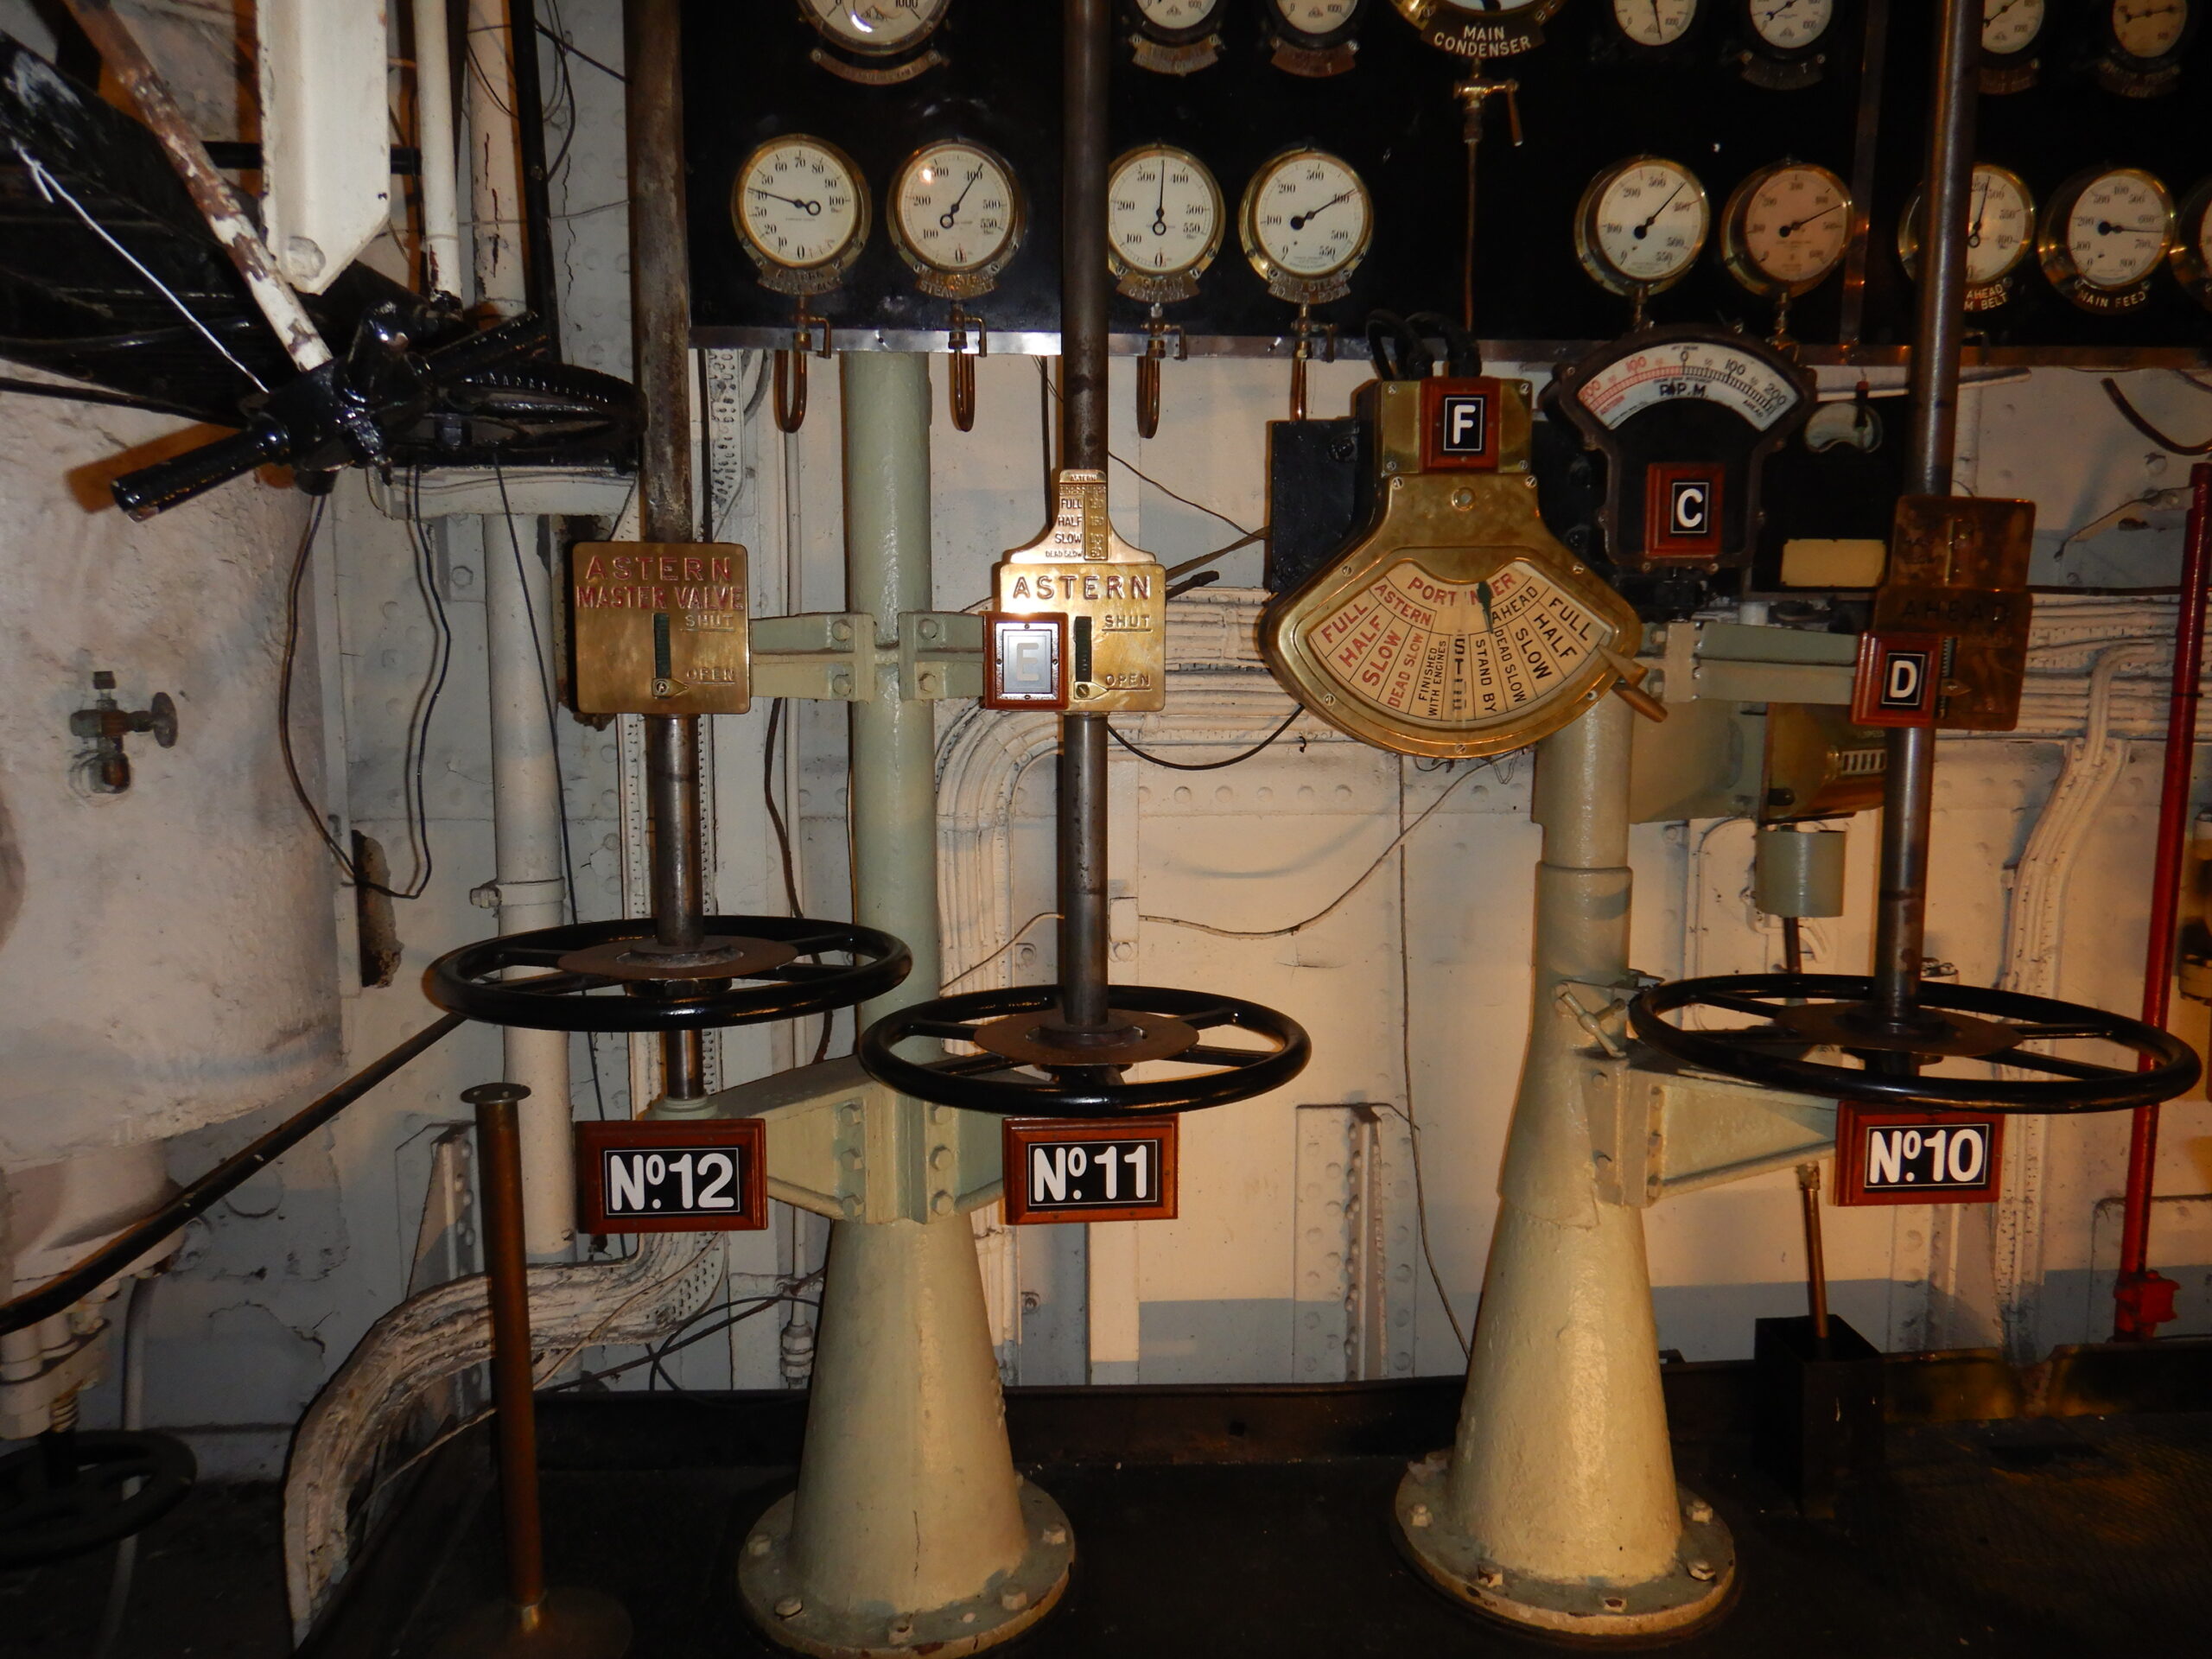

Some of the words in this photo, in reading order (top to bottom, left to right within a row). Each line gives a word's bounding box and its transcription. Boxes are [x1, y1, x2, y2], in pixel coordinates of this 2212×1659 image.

[1463, 24, 1505, 41] MAIN
[1433, 31, 1531, 57] CONDENSER
[775, 162, 787, 172] 60
[811, 163, 824, 174] 80
[824, 178, 836, 188] 90
[1172, 173, 1189, 183] 400
[1278, 183, 1296, 194] 200
[830, 195, 844, 207] 100
[912, 195, 931, 207] 200
[1117, 200, 1135, 211] 200
[1185, 204, 1204, 215] 500
[1183, 223, 1201, 233] 550
[1266, 214, 1281, 226] 100
[764, 225, 776, 235] 20
[923, 228, 938, 239] 100
[1127, 233, 1142, 244] 100
[1331, 230, 1348, 240] 500
[778, 237, 786, 247] 10
[797, 245, 805, 259] 0
[1154, 252, 1163, 268] 0
[1966, 283, 2004, 300] AHEAD
[2079, 289, 2108, 308] MAIN
[2115, 290, 2146, 308] FEED
[1980, 292, 2007, 310] BELT
[1725, 359, 1745, 375] 100
[1764, 383, 1787, 406] 200
[1453, 404, 1476, 444] F
[1061, 498, 1083, 509] FULL
[1676, 487, 1703, 527] C
[1058, 515, 1083, 527] HALF
[1054, 531, 1082, 544] SLOW
[586, 556, 733, 582] ASTERN
[1013, 575, 1151, 600] ASTERN
[1408, 576, 1457, 607] PORT
[576, 586, 667, 608] MASTER
[674, 586, 744, 610] VALVE
[1374, 584, 1433, 626] ASTERN
[1491, 586, 1538, 624] AHEAD
[685, 613, 734, 628] SHUT
[1104, 614, 1151, 629] SHUT
[1321, 604, 1369, 644] FULL
[1548, 597, 1590, 641] FULL
[1338, 614, 1381, 669] HALF
[1534, 613, 1578, 658] HALF
[1362, 629, 1402, 687] SLOW
[1433, 640, 1446, 684] ENGINES
[1516, 627, 1553, 680] SLOW
[1016, 643, 1039, 682] E
[1387, 671, 1411, 709] DEAD
[1403, 632, 1424, 669] SLOW
[1476, 639, 1492, 686] STAND
[1494, 629, 1512, 662] DEAD
[1505, 664, 1528, 703] SLOW
[687, 667, 735, 681] OPEN
[1106, 674, 1151, 687] OPEN
[1419, 647, 1438, 702] FINISHED
[1889, 660, 1917, 698] D
[1427, 690, 1441, 716] WITH
[1483, 693, 1497, 713] BY
